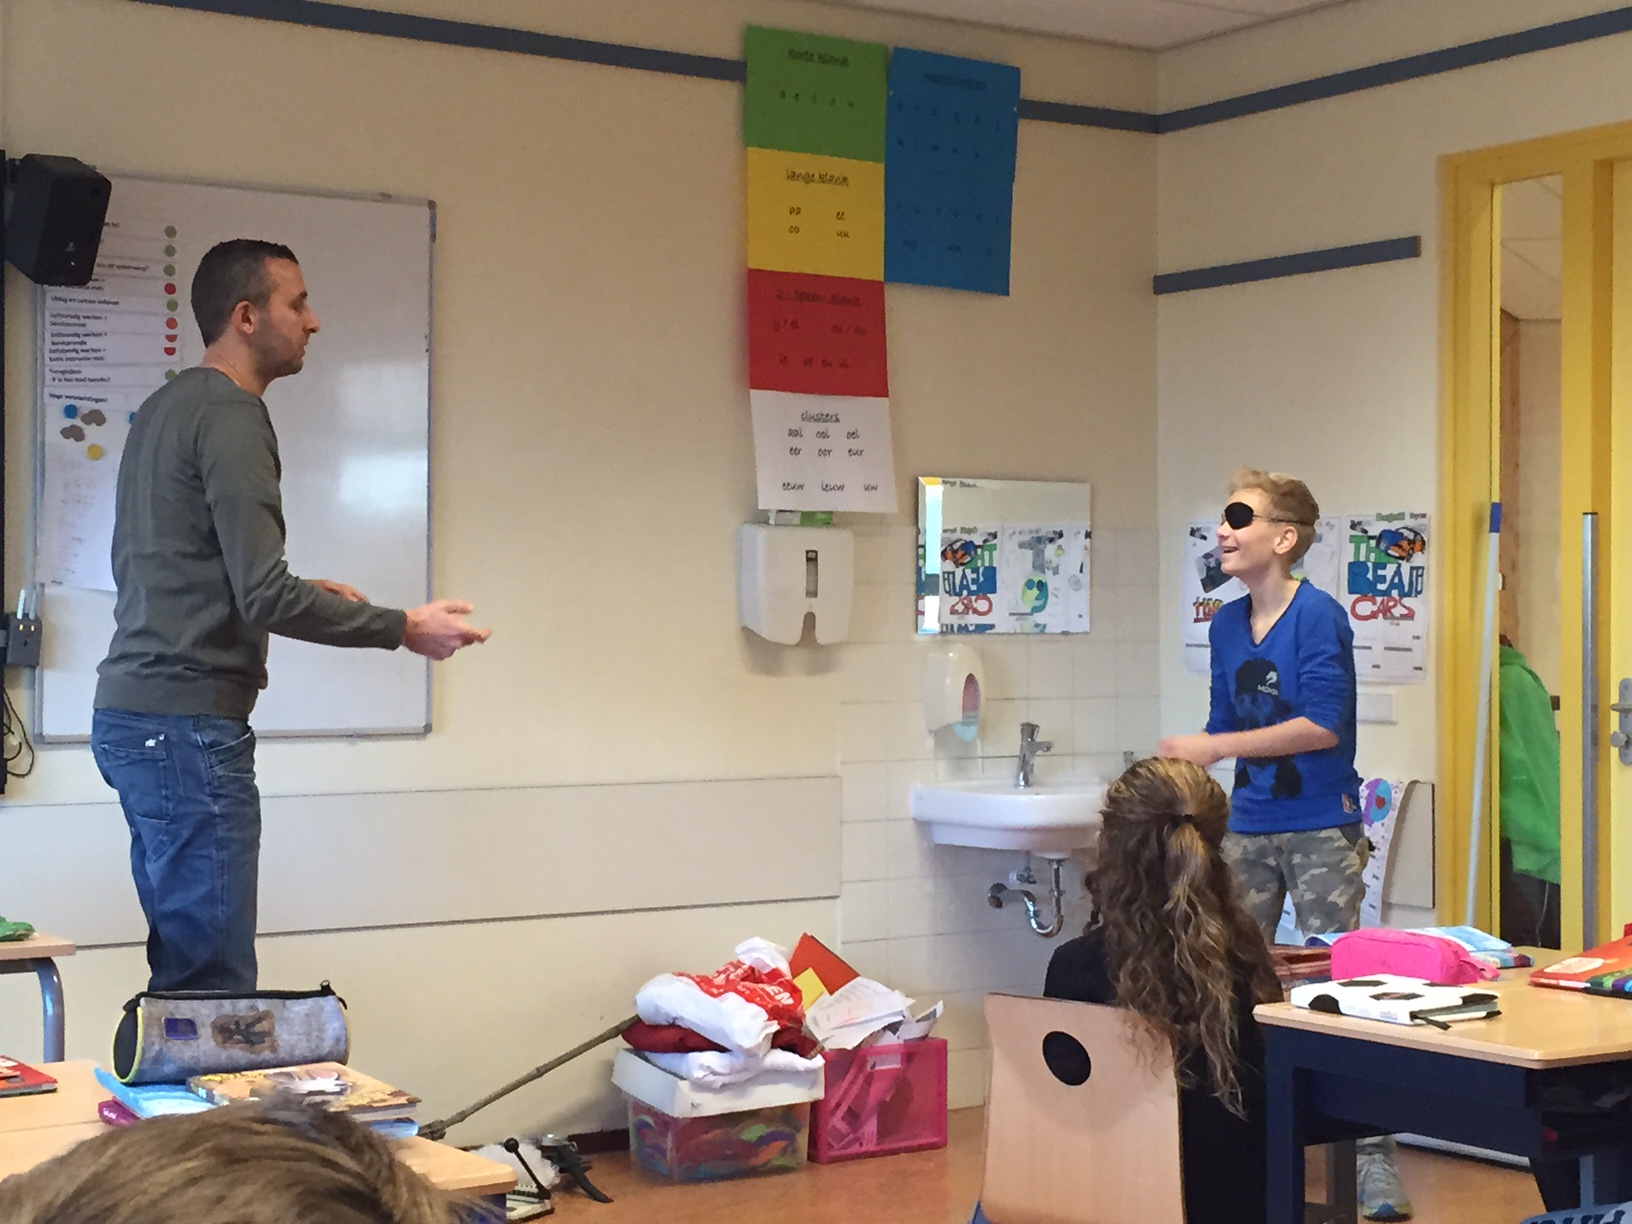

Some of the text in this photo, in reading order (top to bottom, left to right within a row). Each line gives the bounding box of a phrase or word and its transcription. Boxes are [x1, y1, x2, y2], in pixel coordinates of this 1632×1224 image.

[800, 410, 840, 423] clusters
[788, 427, 860, 440] aai ooi oei
[789, 446, 864, 457] eer oor eur
[1350, 595, 1416, 622] CARS
